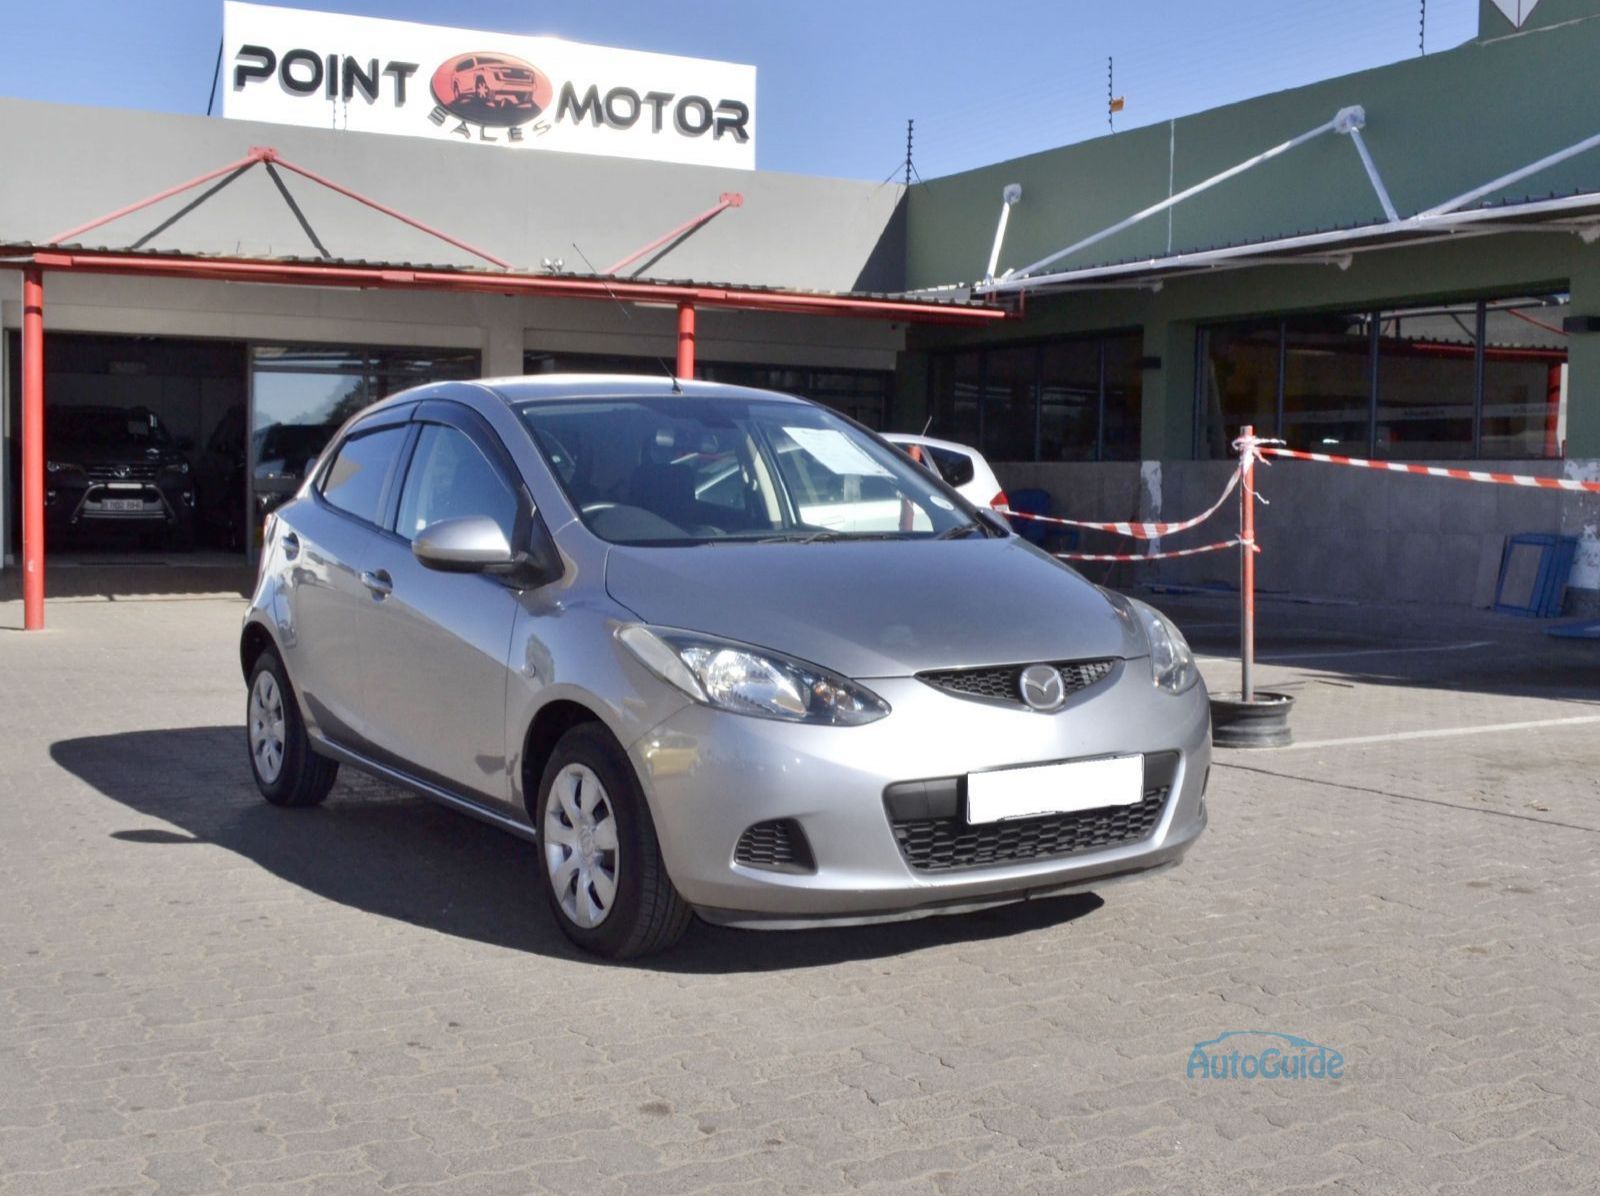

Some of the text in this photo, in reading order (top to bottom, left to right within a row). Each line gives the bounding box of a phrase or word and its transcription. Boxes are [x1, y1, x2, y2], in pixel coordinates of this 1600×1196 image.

[234, 44, 751, 144] POINT MOTOR
[427, 104, 552, 143] SALES
